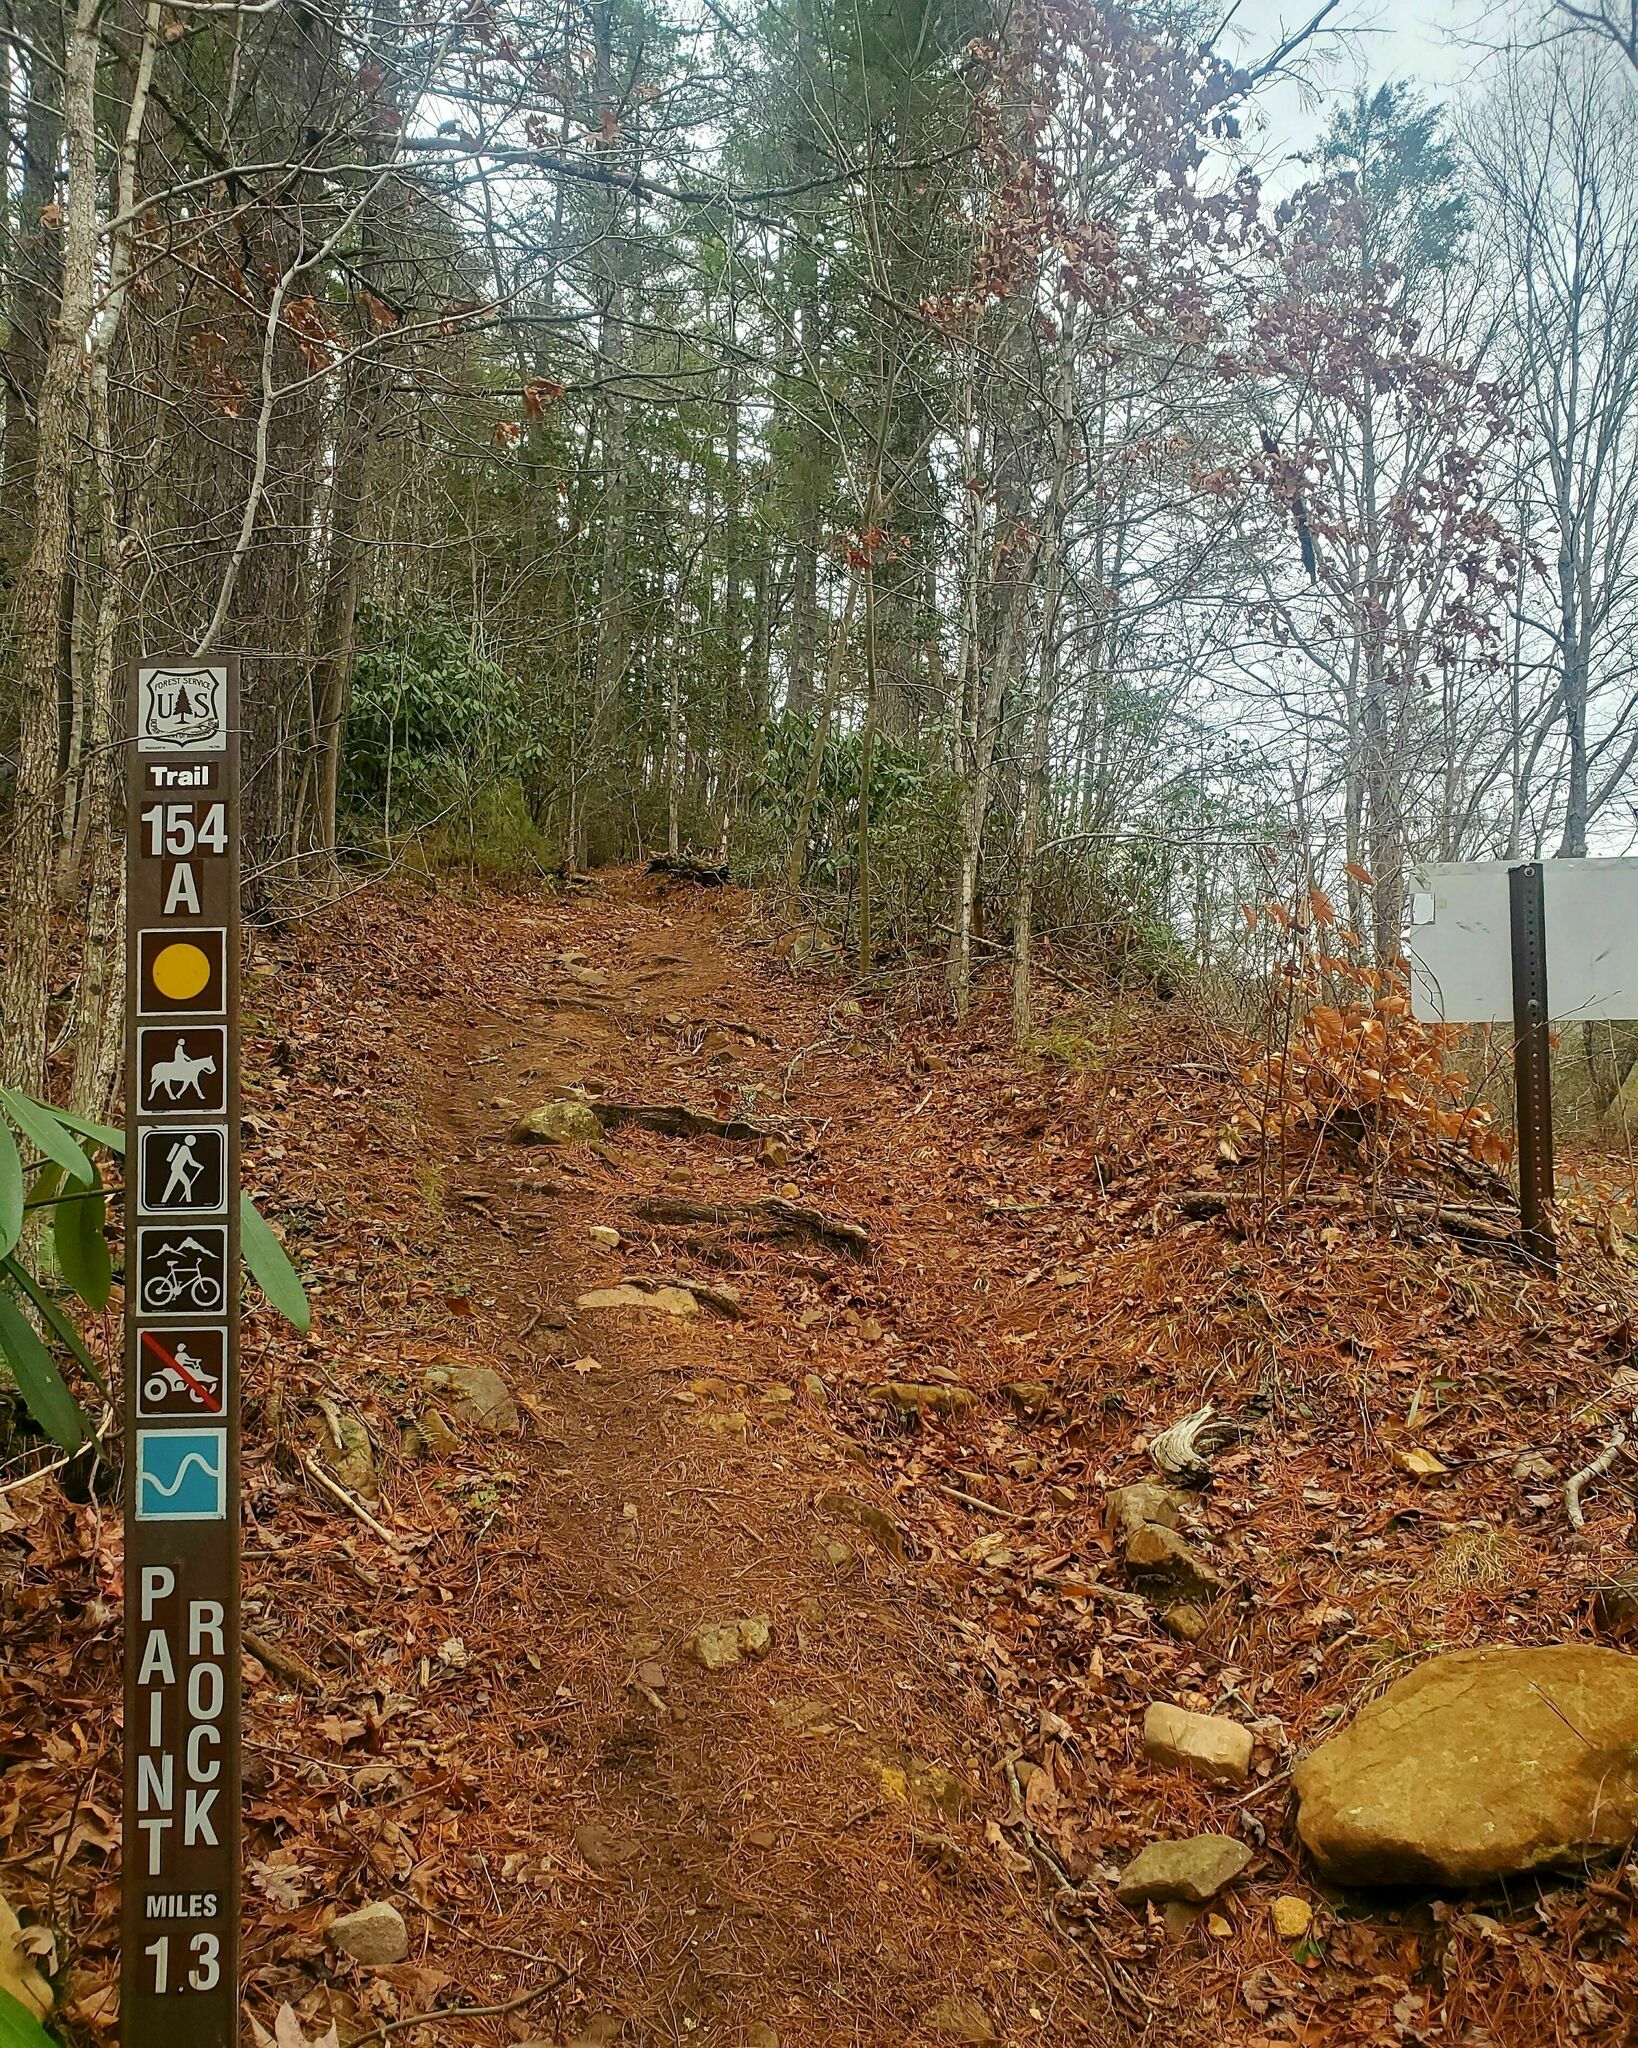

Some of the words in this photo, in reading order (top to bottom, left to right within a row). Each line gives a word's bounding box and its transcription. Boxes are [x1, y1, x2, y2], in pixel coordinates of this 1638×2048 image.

[154, 678, 180, 691] FOREST
[182, 677, 211, 690] SERVICE
[150, 766, 209, 786] Trail
[141, 803, 228, 856] 154
[163, 862, 201, 914] A
[137, 1566, 176, 1876] PAINT
[184, 1600, 225, 1846] ROCK
[146, 1893, 217, 1918] MILES
[145, 1932, 220, 1994] 1.3
